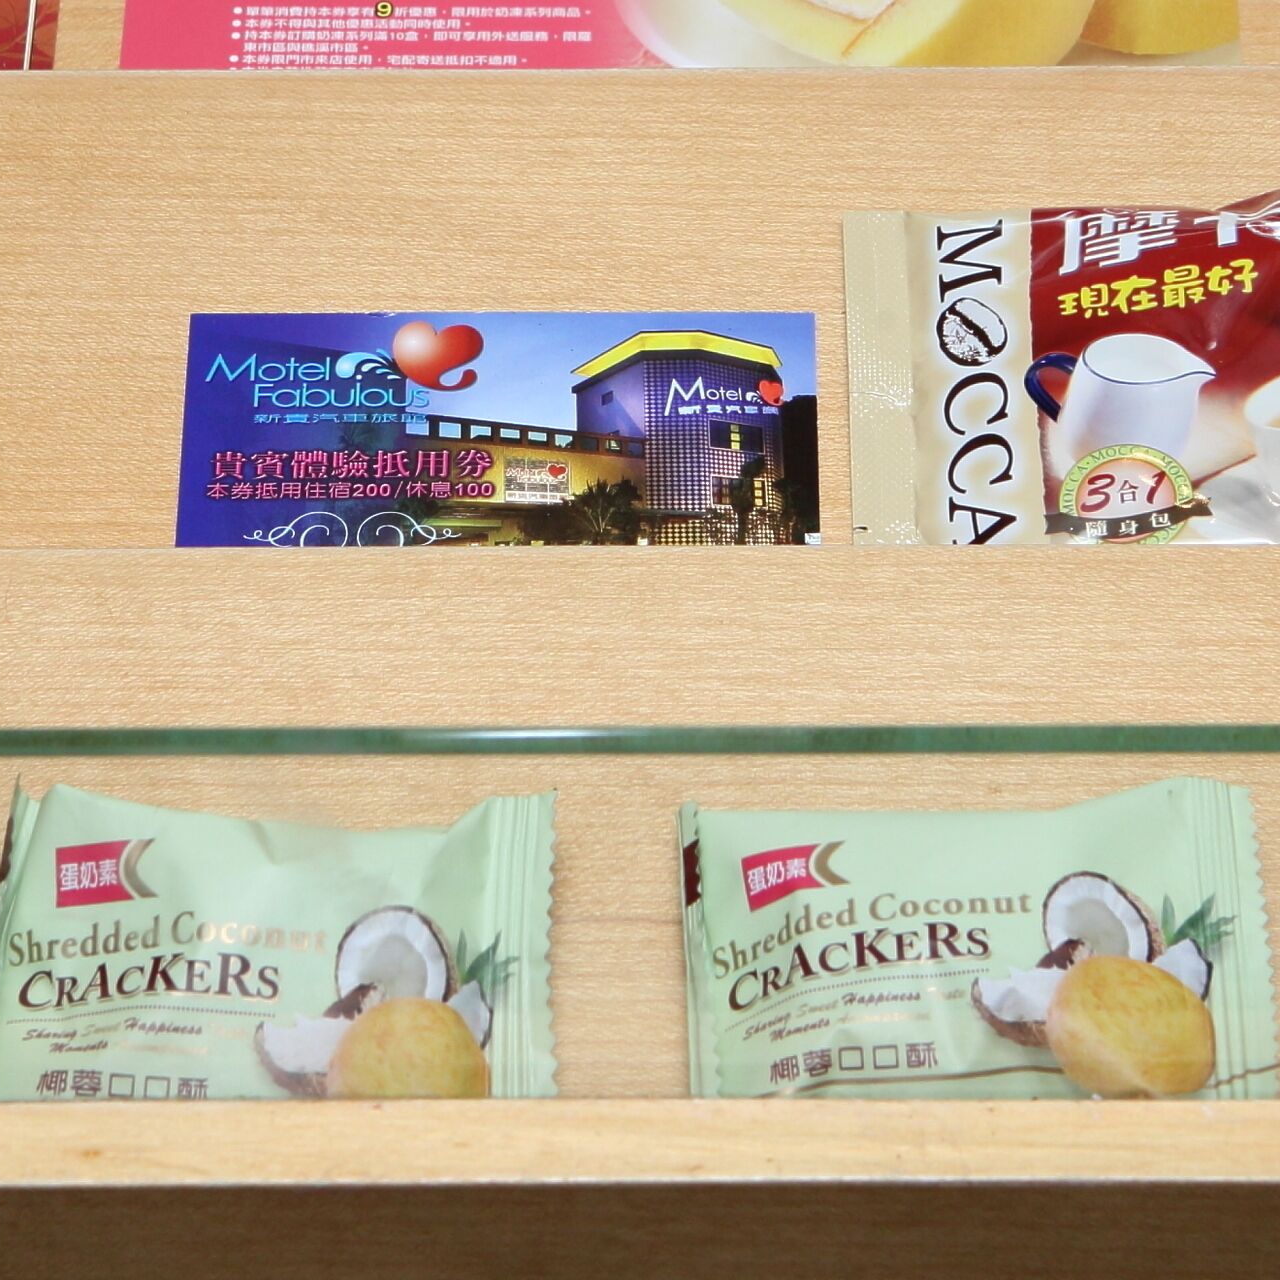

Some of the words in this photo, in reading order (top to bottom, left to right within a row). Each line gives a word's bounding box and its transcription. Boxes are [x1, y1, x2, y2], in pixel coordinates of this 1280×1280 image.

[1057, 259, 1259, 319] 現在最好
[204, 352, 331, 382] Motel
[252, 375, 431, 409] Fabulous
[663, 376, 743, 417] Motel
[209, 449, 494, 480] 貴賓體驗抵用券
[1079, 470, 1167, 513] 3合1
[1085, 512, 1171, 539] 隨身包
[59, 858, 119, 892] 蛋奶素
[746, 855, 808, 895] 蛋奶素
[8, 913, 161, 968] Shredded
[171, 911, 330, 956] Coconut
[711, 897, 858, 981] Shredded
[868, 891, 1033, 923] Coconut
[19, 951, 282, 1010] CRACKERS
[727, 921, 992, 1013] CRACKERS
[22, 1028, 78, 1042] Sharing
[123, 1017, 203, 1036] Happiness
[742, 1011, 792, 1042] Sharing
[840, 991, 922, 1007] Happiness
[769, 1016, 831, 1042] Moments
[48, 1040, 109, 1054] Moments
